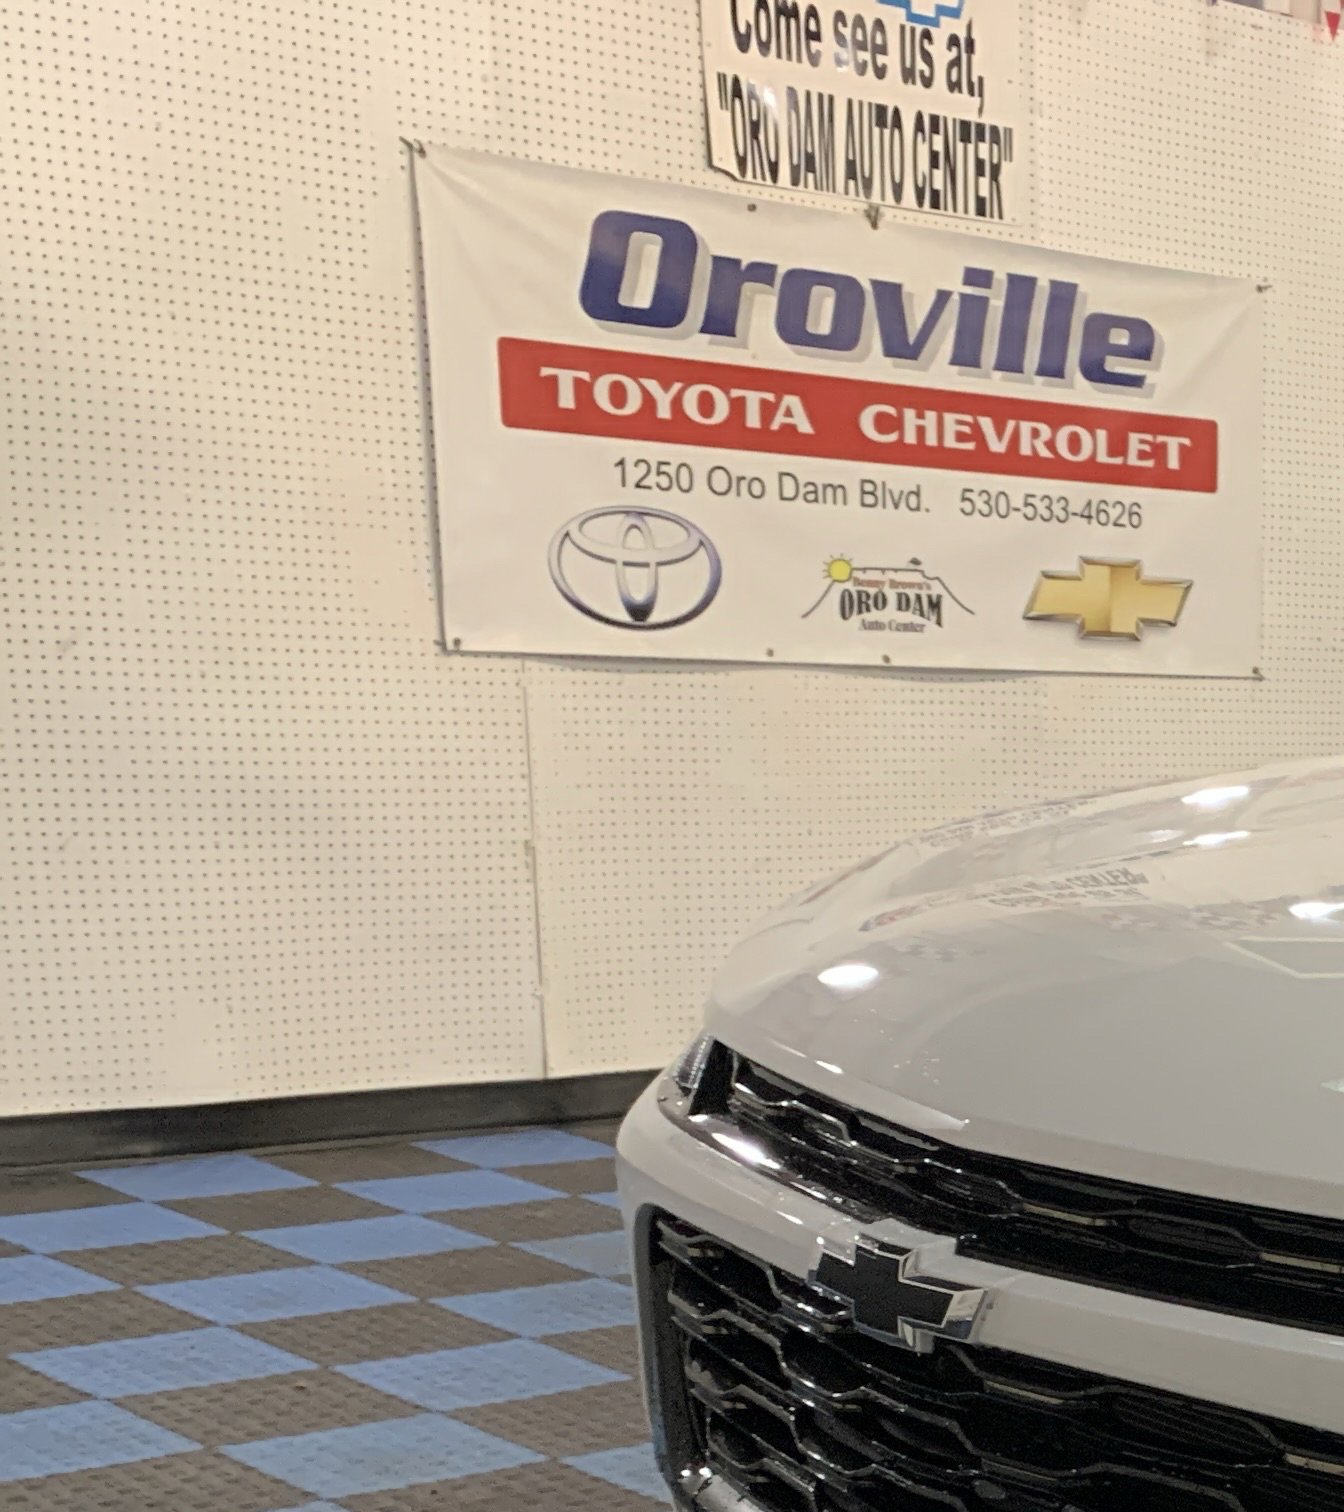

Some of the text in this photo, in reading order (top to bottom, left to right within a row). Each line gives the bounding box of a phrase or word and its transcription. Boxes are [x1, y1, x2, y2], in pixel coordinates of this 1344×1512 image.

[730, 0, 985, 118] Come see us at,
[786, 86, 837, 194] DAM
[844, 97, 905, 205] AUTO
[912, 110, 1014, 220] CENTER"
[577, 209, 1161, 392] Oroville
[539, 366, 1193, 472] TOYOTA CHEVROLET
[613, 456, 1143, 531] 1250 Oro Dam Blvd. 530-533-4626
[839, 588, 943, 628] ORO DAM
[859, 619, 886, 631] Auto
